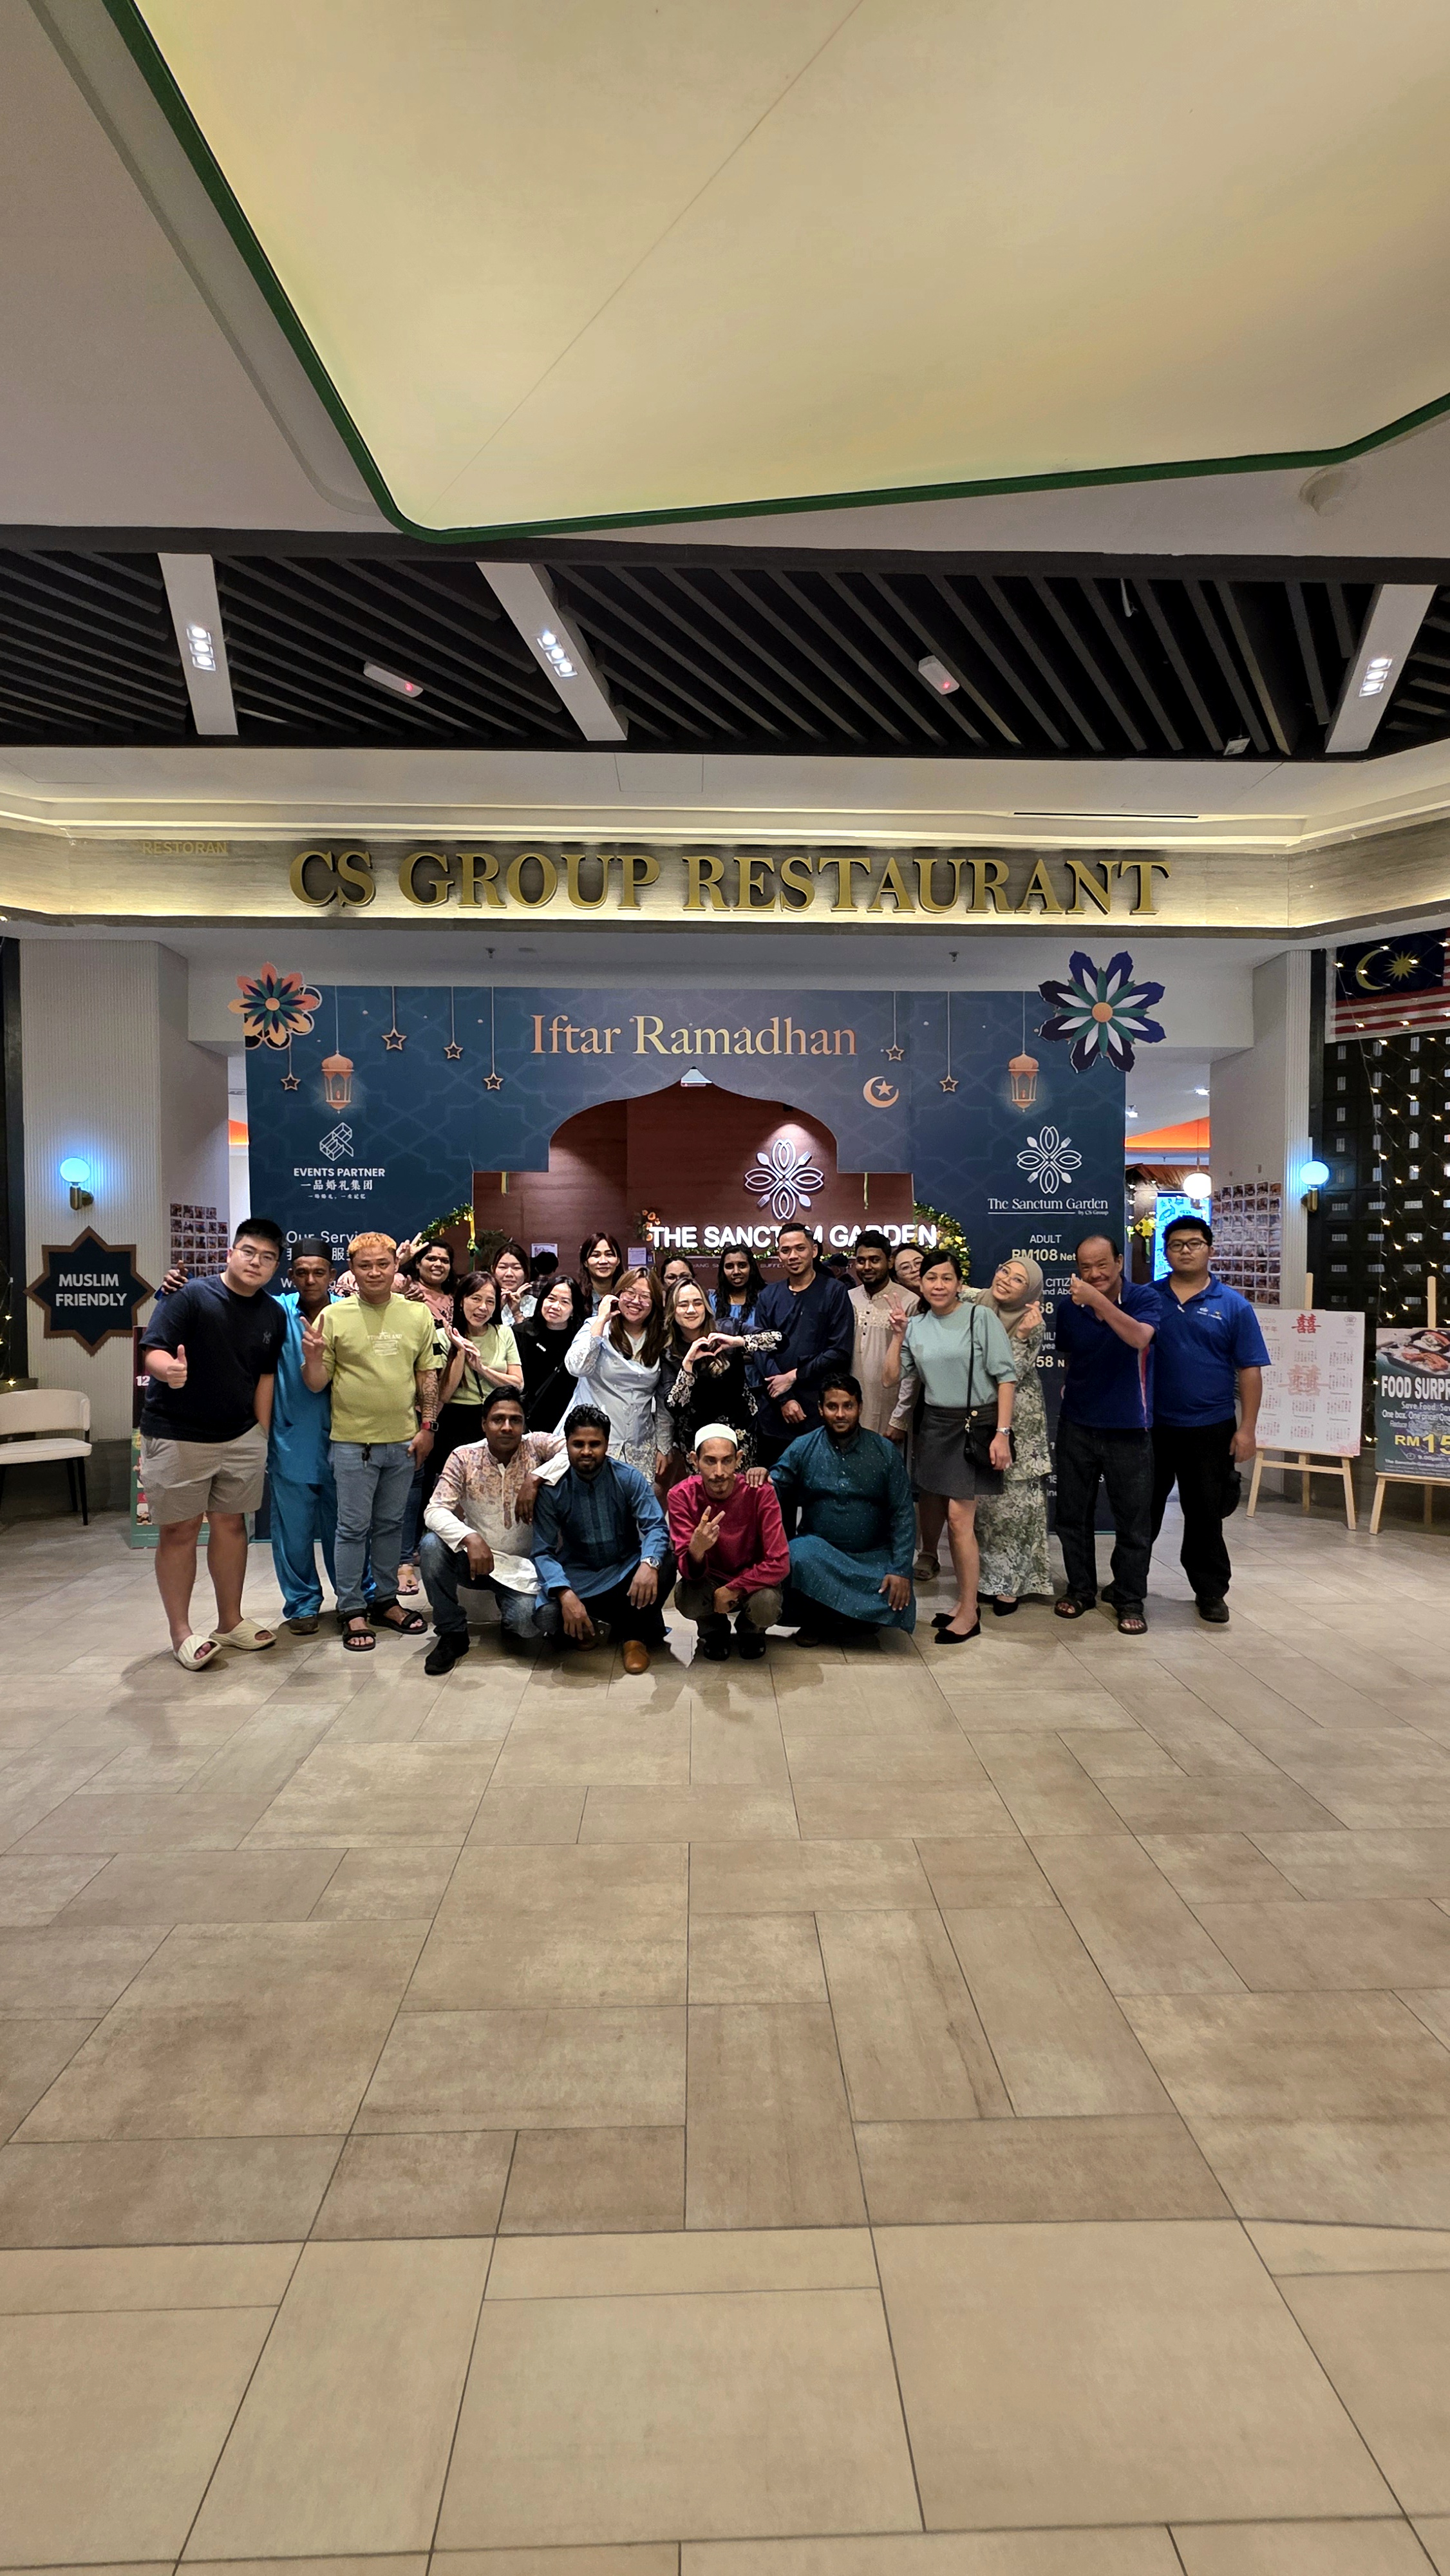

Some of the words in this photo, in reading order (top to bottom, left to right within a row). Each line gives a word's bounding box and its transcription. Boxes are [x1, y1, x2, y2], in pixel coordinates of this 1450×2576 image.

[143, 841, 227, 855] RESTORAN
[289, 851, 375, 907] CS
[398, 851, 661, 909] GROUP
[682, 855, 1171, 916] RESTAURANT
[531, 1014, 621, 1054] Iftar
[632, 1015, 858, 1056] Ramadhan
[294, 1168, 335, 1177] EVENTS
[337, 1168, 386, 1177] PARTNER
[300, 1179, 373, 1191] 一品婚礼集团
[987, 1198, 1009, 1209] The
[1012, 1198, 1063, 1209] Sanctum
[1066, 1198, 1108, 1209] Garden
[648, 1226, 698, 1248] THE
[704, 1226, 823, 1248] SANCTM
[1030, 1235, 1062, 1243] ADULT
[1012, 1249, 1058, 1261] RM108
[1060, 1253, 1077, 1261] Net
[59, 1274, 119, 1287] MUSLIM
[55, 1293, 127, 1307] FRIENDLY
[1381, 1375, 1412, 1398] FOOD
